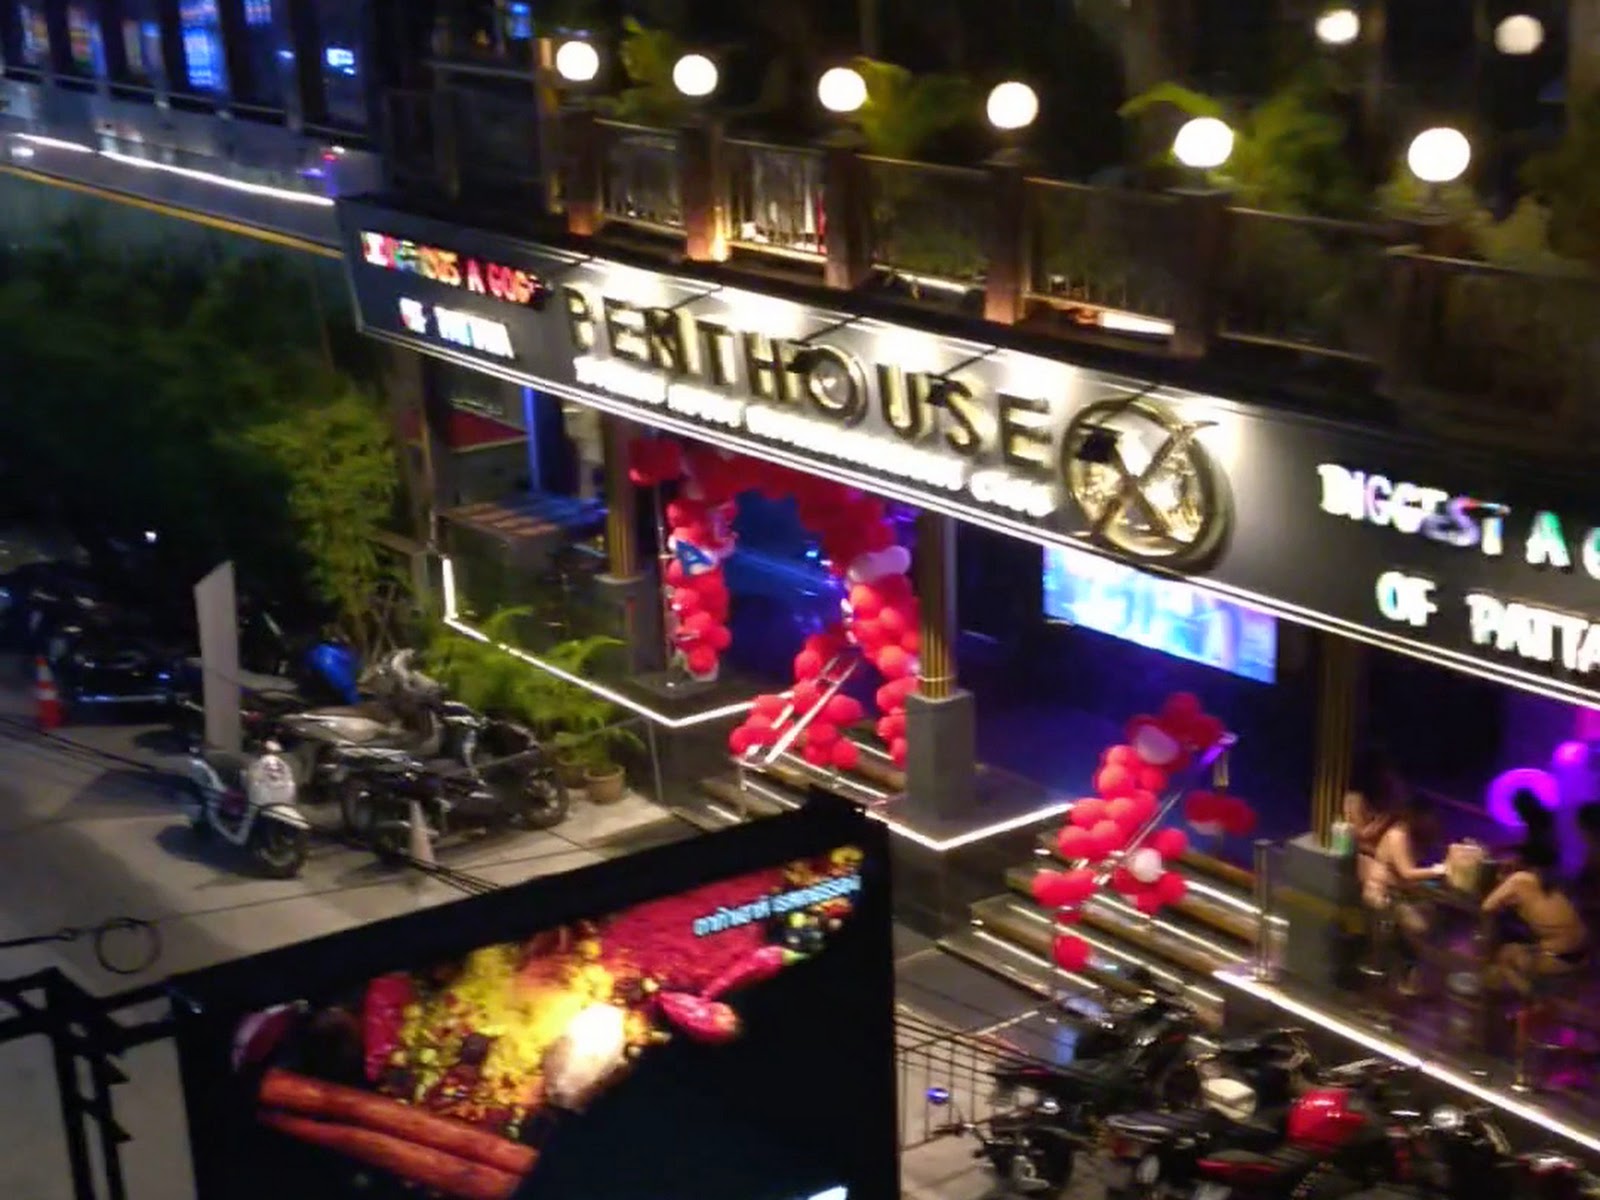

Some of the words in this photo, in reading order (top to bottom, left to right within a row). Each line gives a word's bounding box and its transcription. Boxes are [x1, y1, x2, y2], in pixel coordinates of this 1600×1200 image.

[562, 285, 1053, 470] PENTHOUSE
[1524, 511, 1571, 567] A
[1375, 570, 1438, 627] OF
